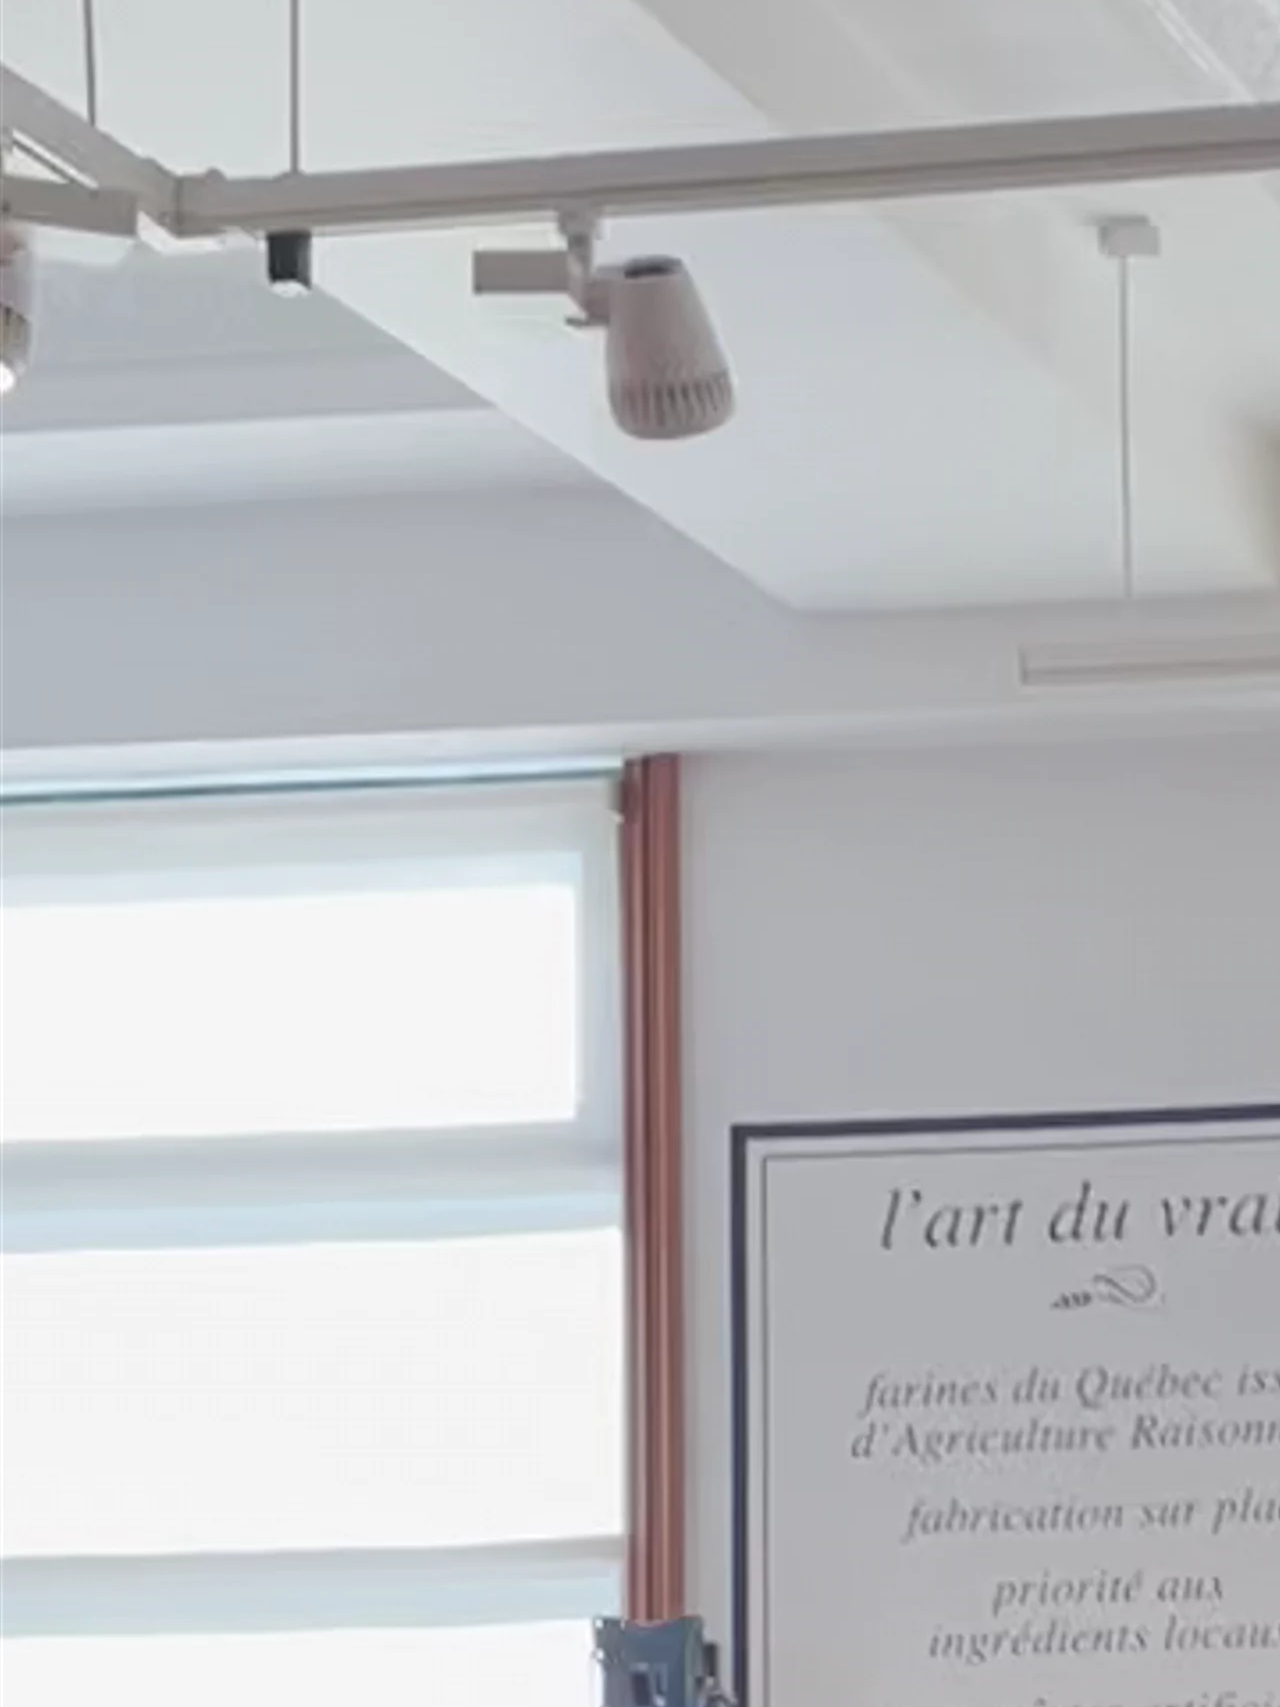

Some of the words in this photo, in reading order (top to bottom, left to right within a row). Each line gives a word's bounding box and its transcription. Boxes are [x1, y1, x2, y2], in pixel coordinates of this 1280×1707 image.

[880, 1186, 1024, 1251] l'art
[1047, 1177, 1131, 1244] du
[860, 1369, 999, 1420] farines
[1011, 1364, 1062, 1407] du
[1074, 1361, 1223, 1410] Québec
[850, 1410, 1118, 1463] d'Agriculture
[903, 1493, 1124, 1545] fabrication
[1138, 1500, 1199, 1532] sur
[991, 1565, 1145, 1618] priorité
[1155, 1575, 1225, 1605] aux
[928, 1618, 1152, 1666] ingrédients
